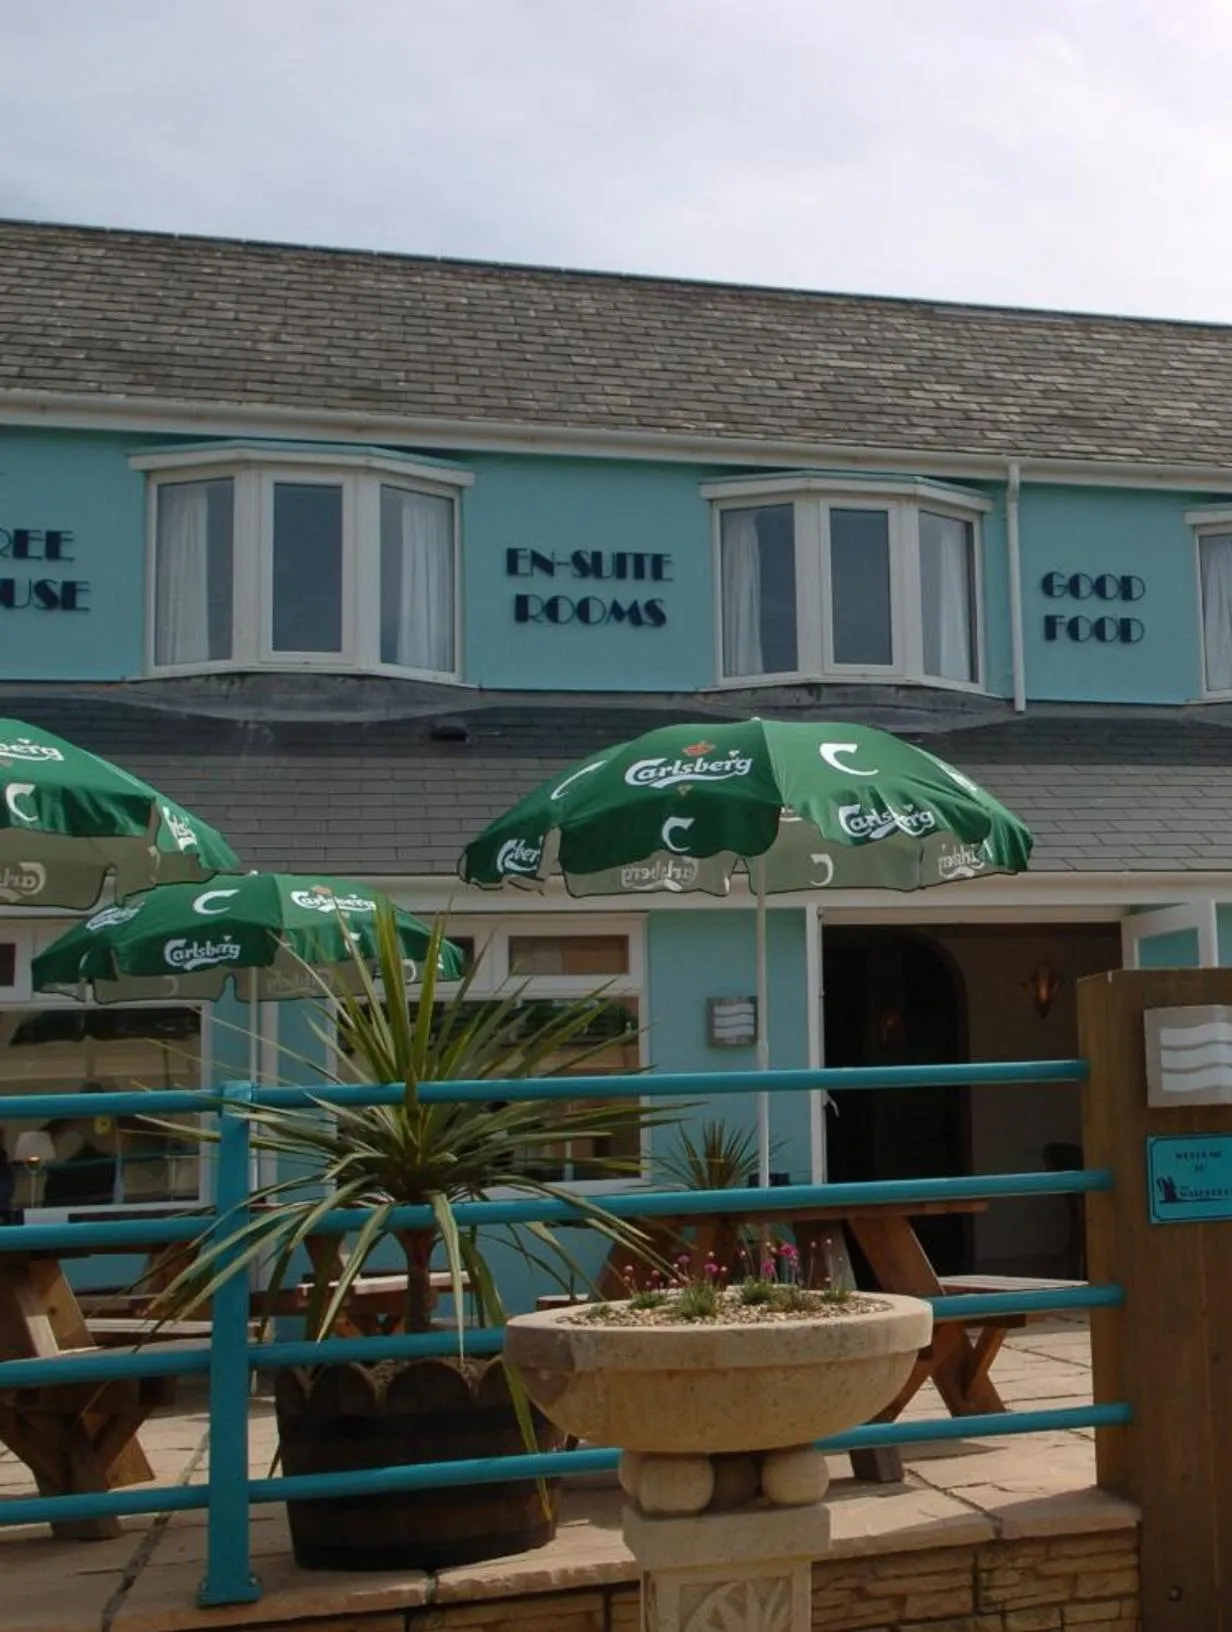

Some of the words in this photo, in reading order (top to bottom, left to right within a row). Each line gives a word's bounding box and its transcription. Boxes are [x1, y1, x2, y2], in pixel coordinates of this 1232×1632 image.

[506, 547, 674, 582] EN-SUITE
[1041, 571, 1146, 601] GOOD
[514, 594, 667, 628] ROOMS
[1044, 614, 1146, 644] FOOD
[624, 751, 753, 789] Carlsberg
[164, 935, 241, 971] Carlsberg
